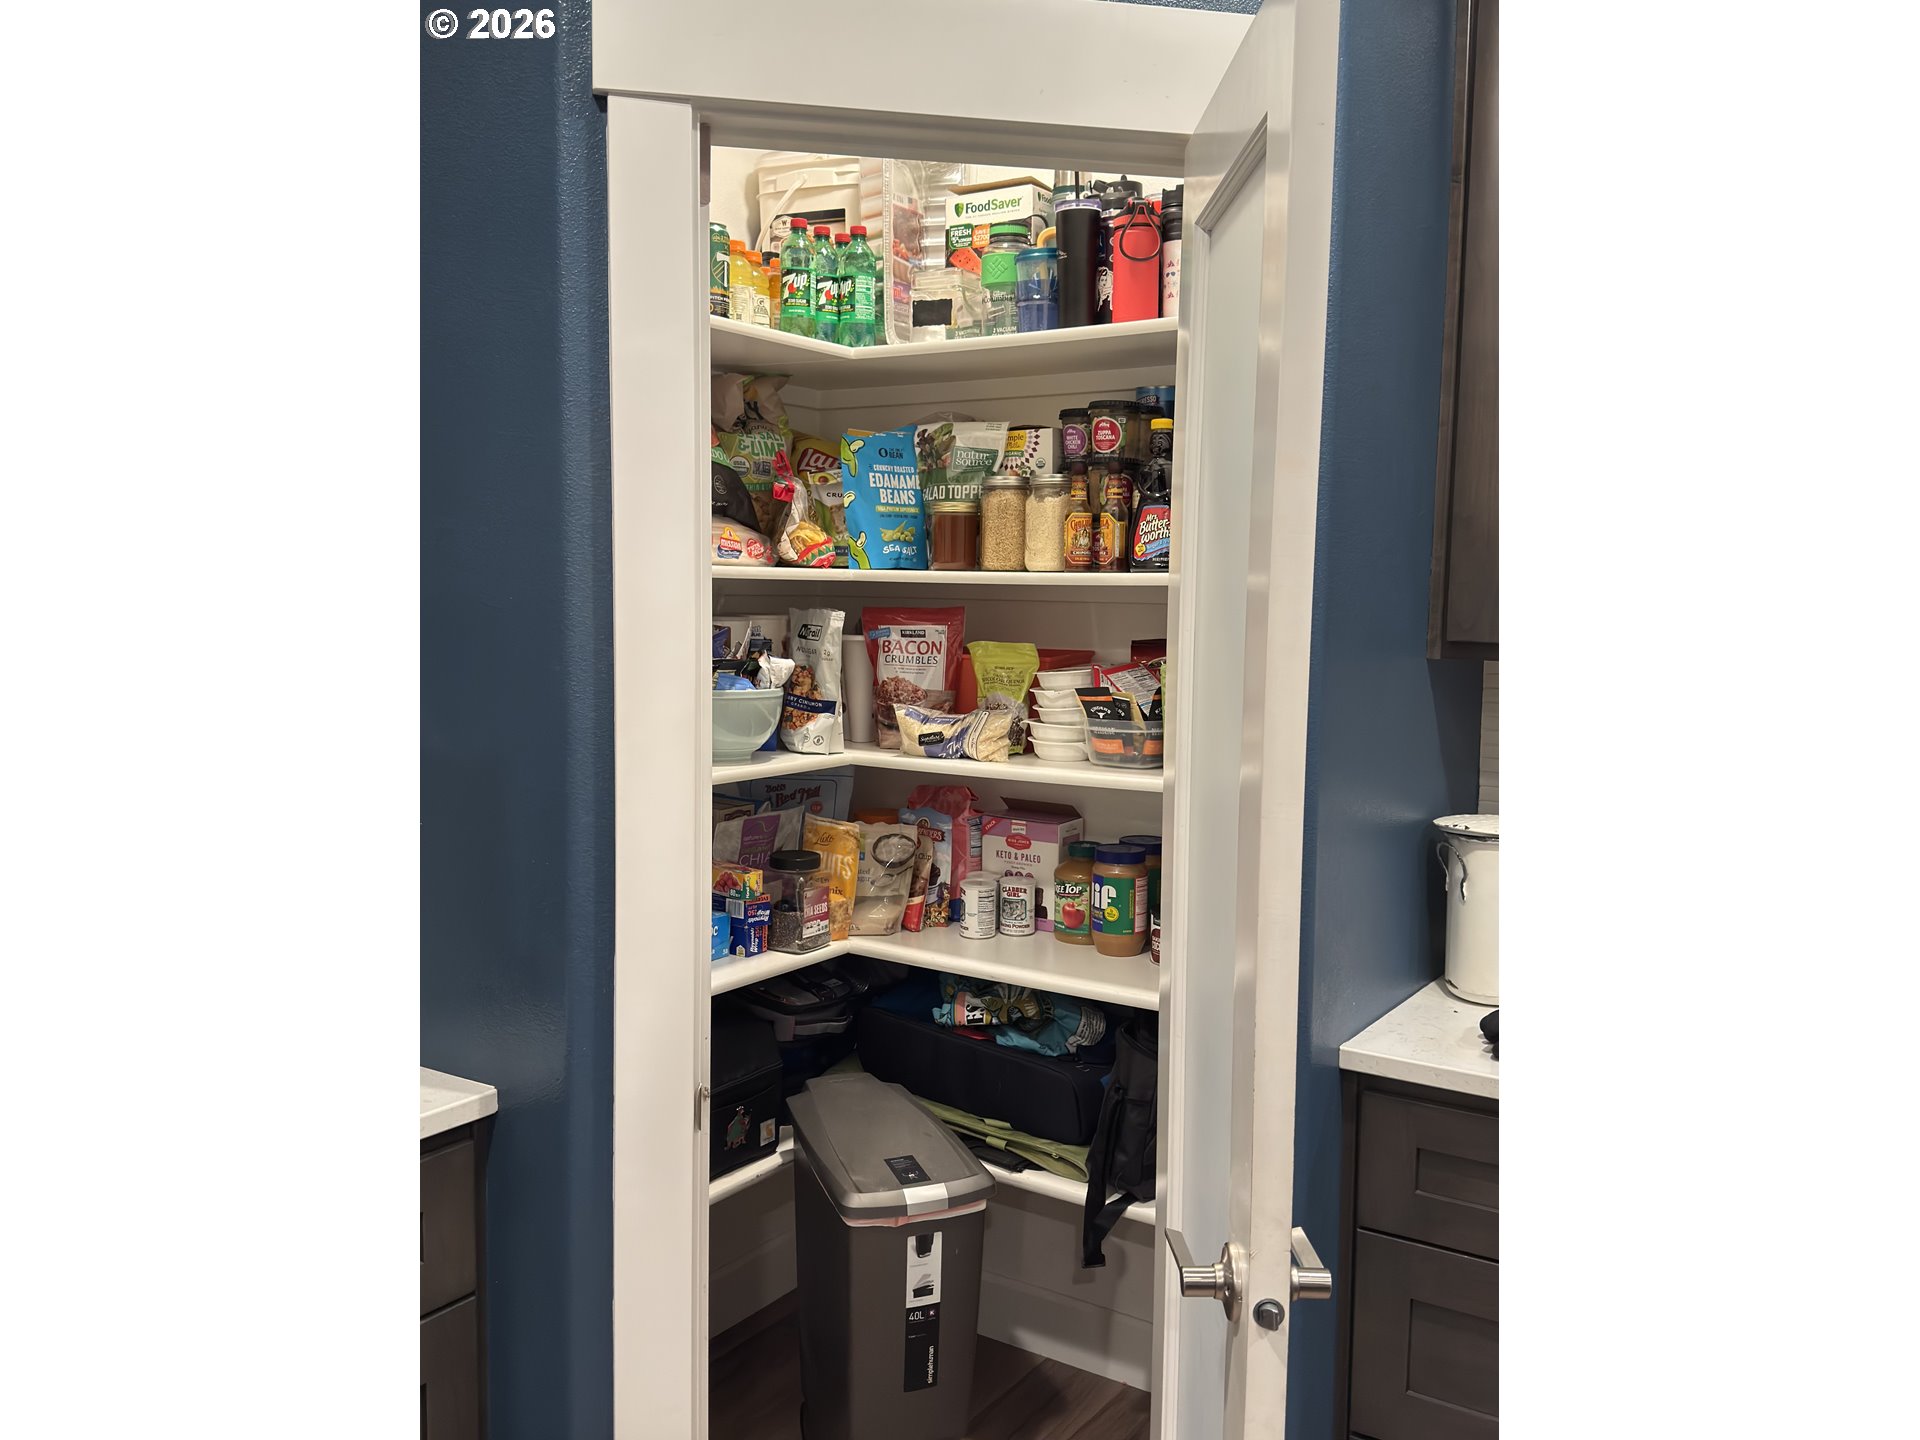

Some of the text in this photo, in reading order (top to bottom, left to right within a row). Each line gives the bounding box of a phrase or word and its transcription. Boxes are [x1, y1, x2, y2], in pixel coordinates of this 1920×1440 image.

[965, 197, 1022, 214] FoodSaver
[950, 229, 972, 237] FRESH
[782, 273, 808, 299] 7up
[873, 464, 915, 473] CRUNCHY ROASTED
[955, 458, 993, 467] source
[879, 488, 916, 505] BEANS
[882, 543, 918, 556] SEA SALT
[882, 640, 943, 655] BACON
[884, 654, 939, 665] CRUMBLES
[775, 789, 798, 807] Red
[995, 850, 1041, 863] KETO & PALEO
[1001, 886, 1028, 895] CLABBER
[813, 902, 828, 915] SEEDS
[908, 1311, 925, 1321] 40L
[926, 1345, 935, 1384] simplehuman
